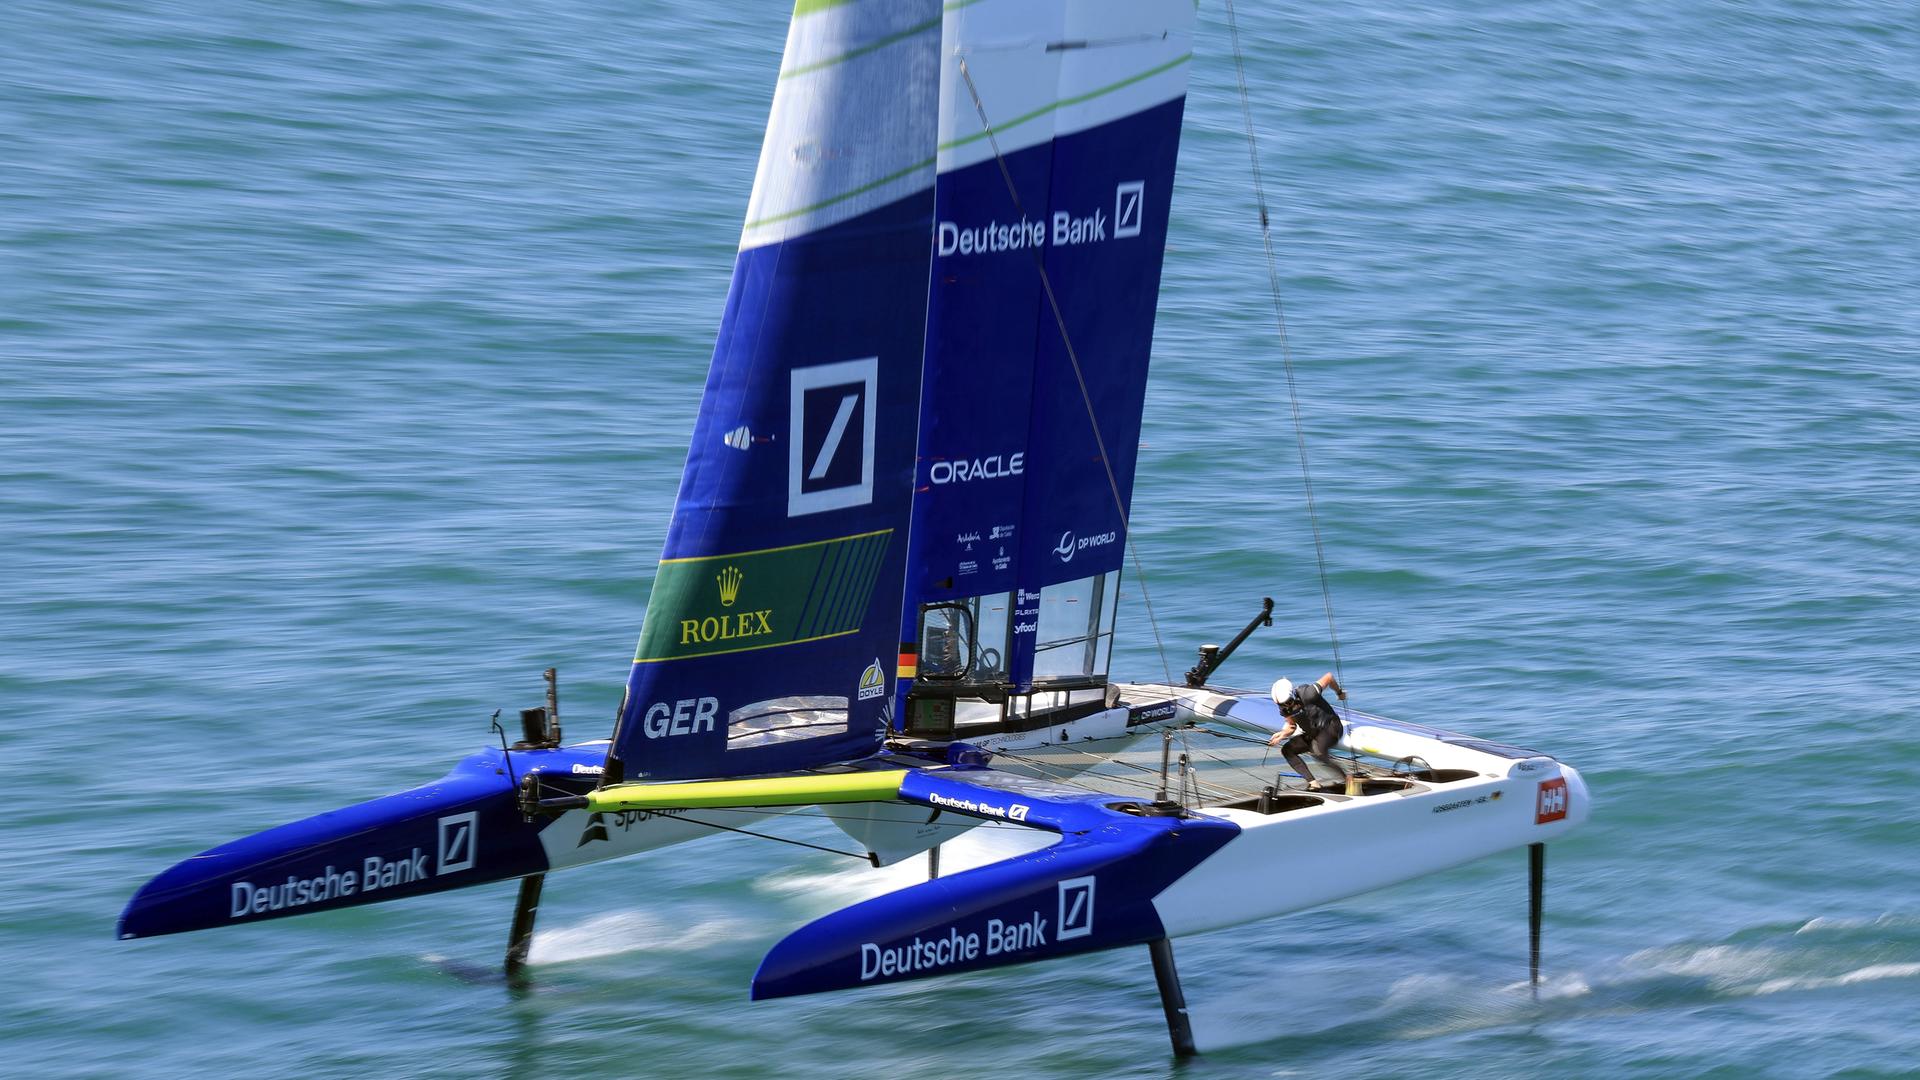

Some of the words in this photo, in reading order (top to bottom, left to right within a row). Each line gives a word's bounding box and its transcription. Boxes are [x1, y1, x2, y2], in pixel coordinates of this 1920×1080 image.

[938, 217, 1046, 257] Deutsche
[1052, 208, 1107, 247] Bank
[930, 452, 1025, 484] ORACLE
[1078, 538, 1089, 550] DP
[1089, 531, 1116, 547] WORLD
[680, 609, 773, 644] ROLEX
[859, 687, 883, 698] DOYLE
[644, 696, 719, 740] GER
[929, 792, 978, 812] Deutsche
[978, 802, 1006, 819] Bank
[230, 864, 360, 918] Deutsche
[362, 847, 430, 892] Bank
[860, 926, 979, 981] Deutsche
[985, 911, 1048, 956] Bank
